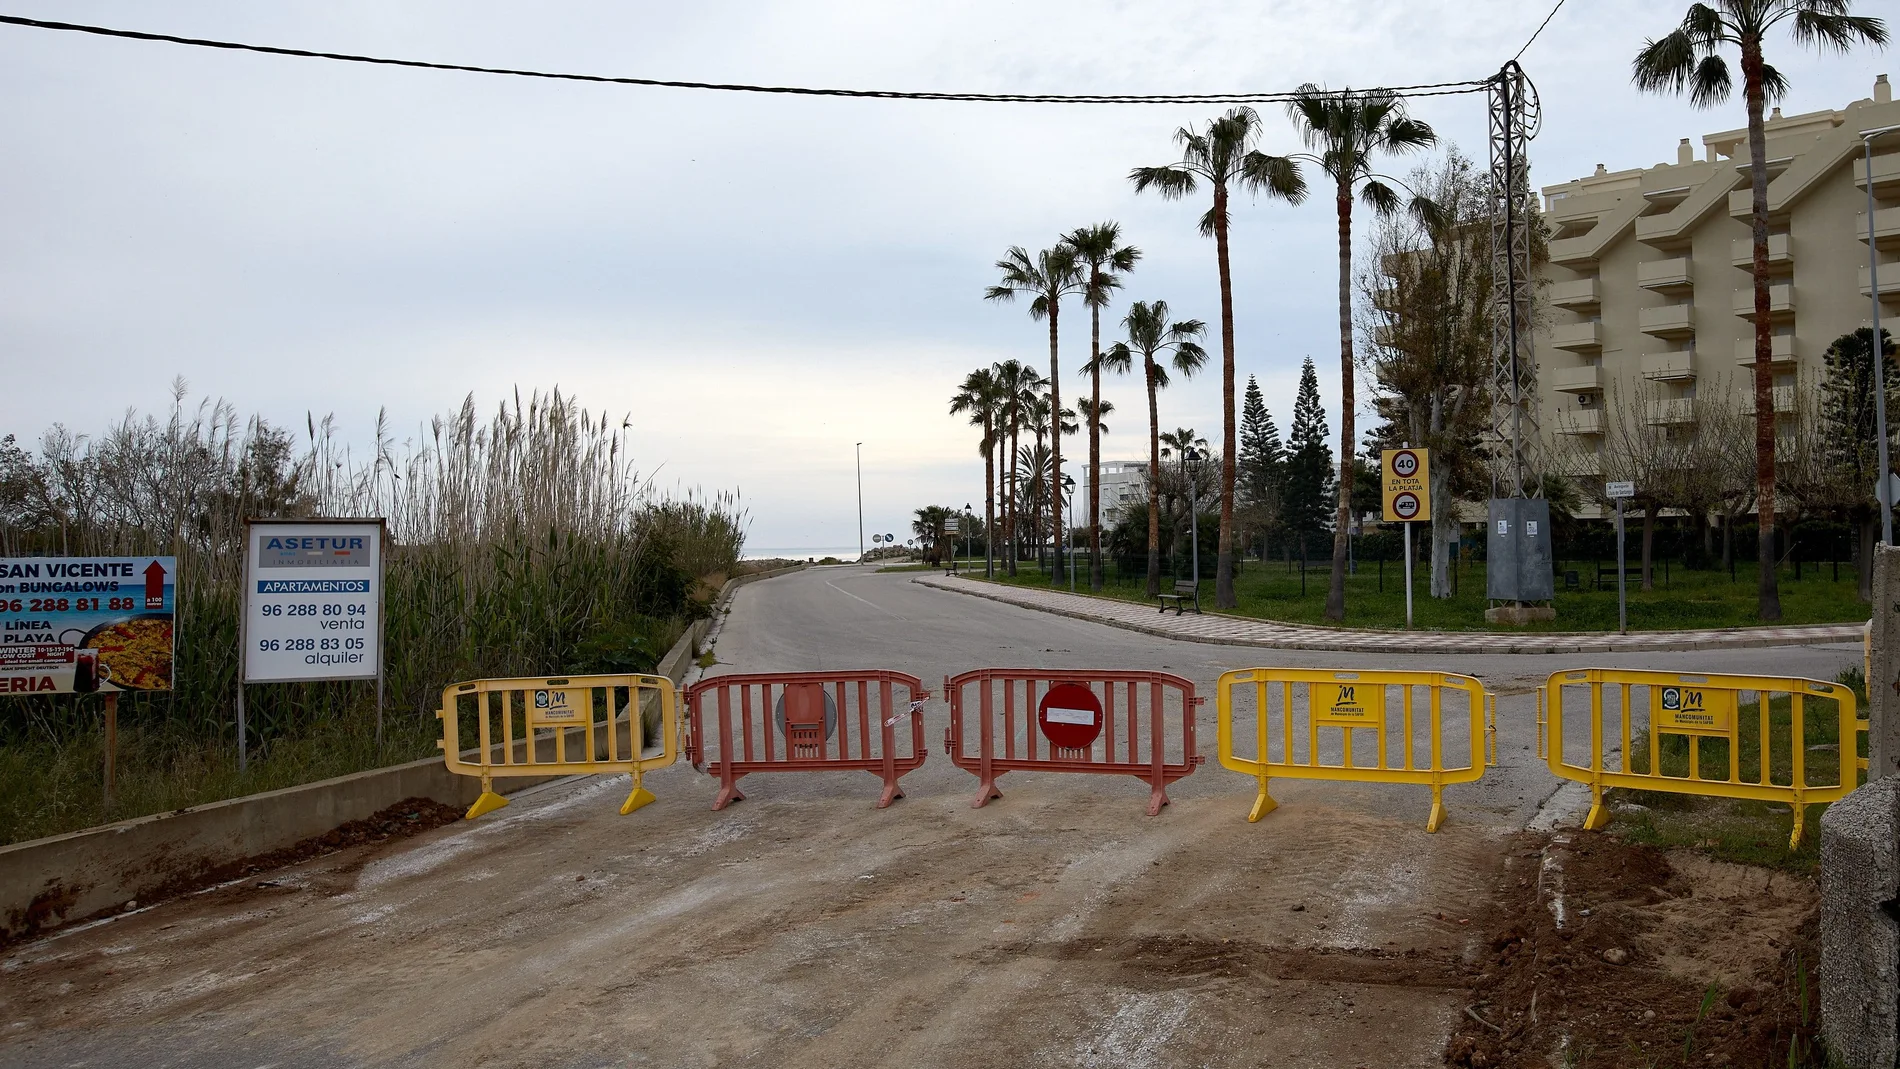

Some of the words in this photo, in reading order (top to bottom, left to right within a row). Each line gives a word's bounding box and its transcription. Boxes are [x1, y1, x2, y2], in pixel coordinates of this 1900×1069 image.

[1397, 460, 1414, 468] 40
[266, 538, 363, 550] ASETUR
[0, 563, 39, 578] SAN
[46, 563, 134, 578] VICENTE
[20, 581, 119, 594] BUNGALOWS
[263, 581, 364, 592] APARTAMENTOS
[0, 598, 22, 612] 96
[29, 598, 70, 612] 288
[76, 597, 99, 611] 81
[108, 597, 134, 611] 88
[262, 604, 282, 616] 96
[287, 604, 317, 616] 288
[322, 604, 342, 616] 80
[347, 603, 366, 616] 94
[5, 619, 52, 631] LÍNEA
[320, 618, 365, 630] venta
[4, 633, 55, 644] PLAYA
[259, 639, 280, 651] 96
[285, 639, 315, 651] 288
[320, 638, 340, 650] 83
[345, 637, 364, 649] 05
[0, 646, 36, 654] WINTER
[304, 652, 364, 666] alquiler
[0, 676, 56, 692] ERIA
